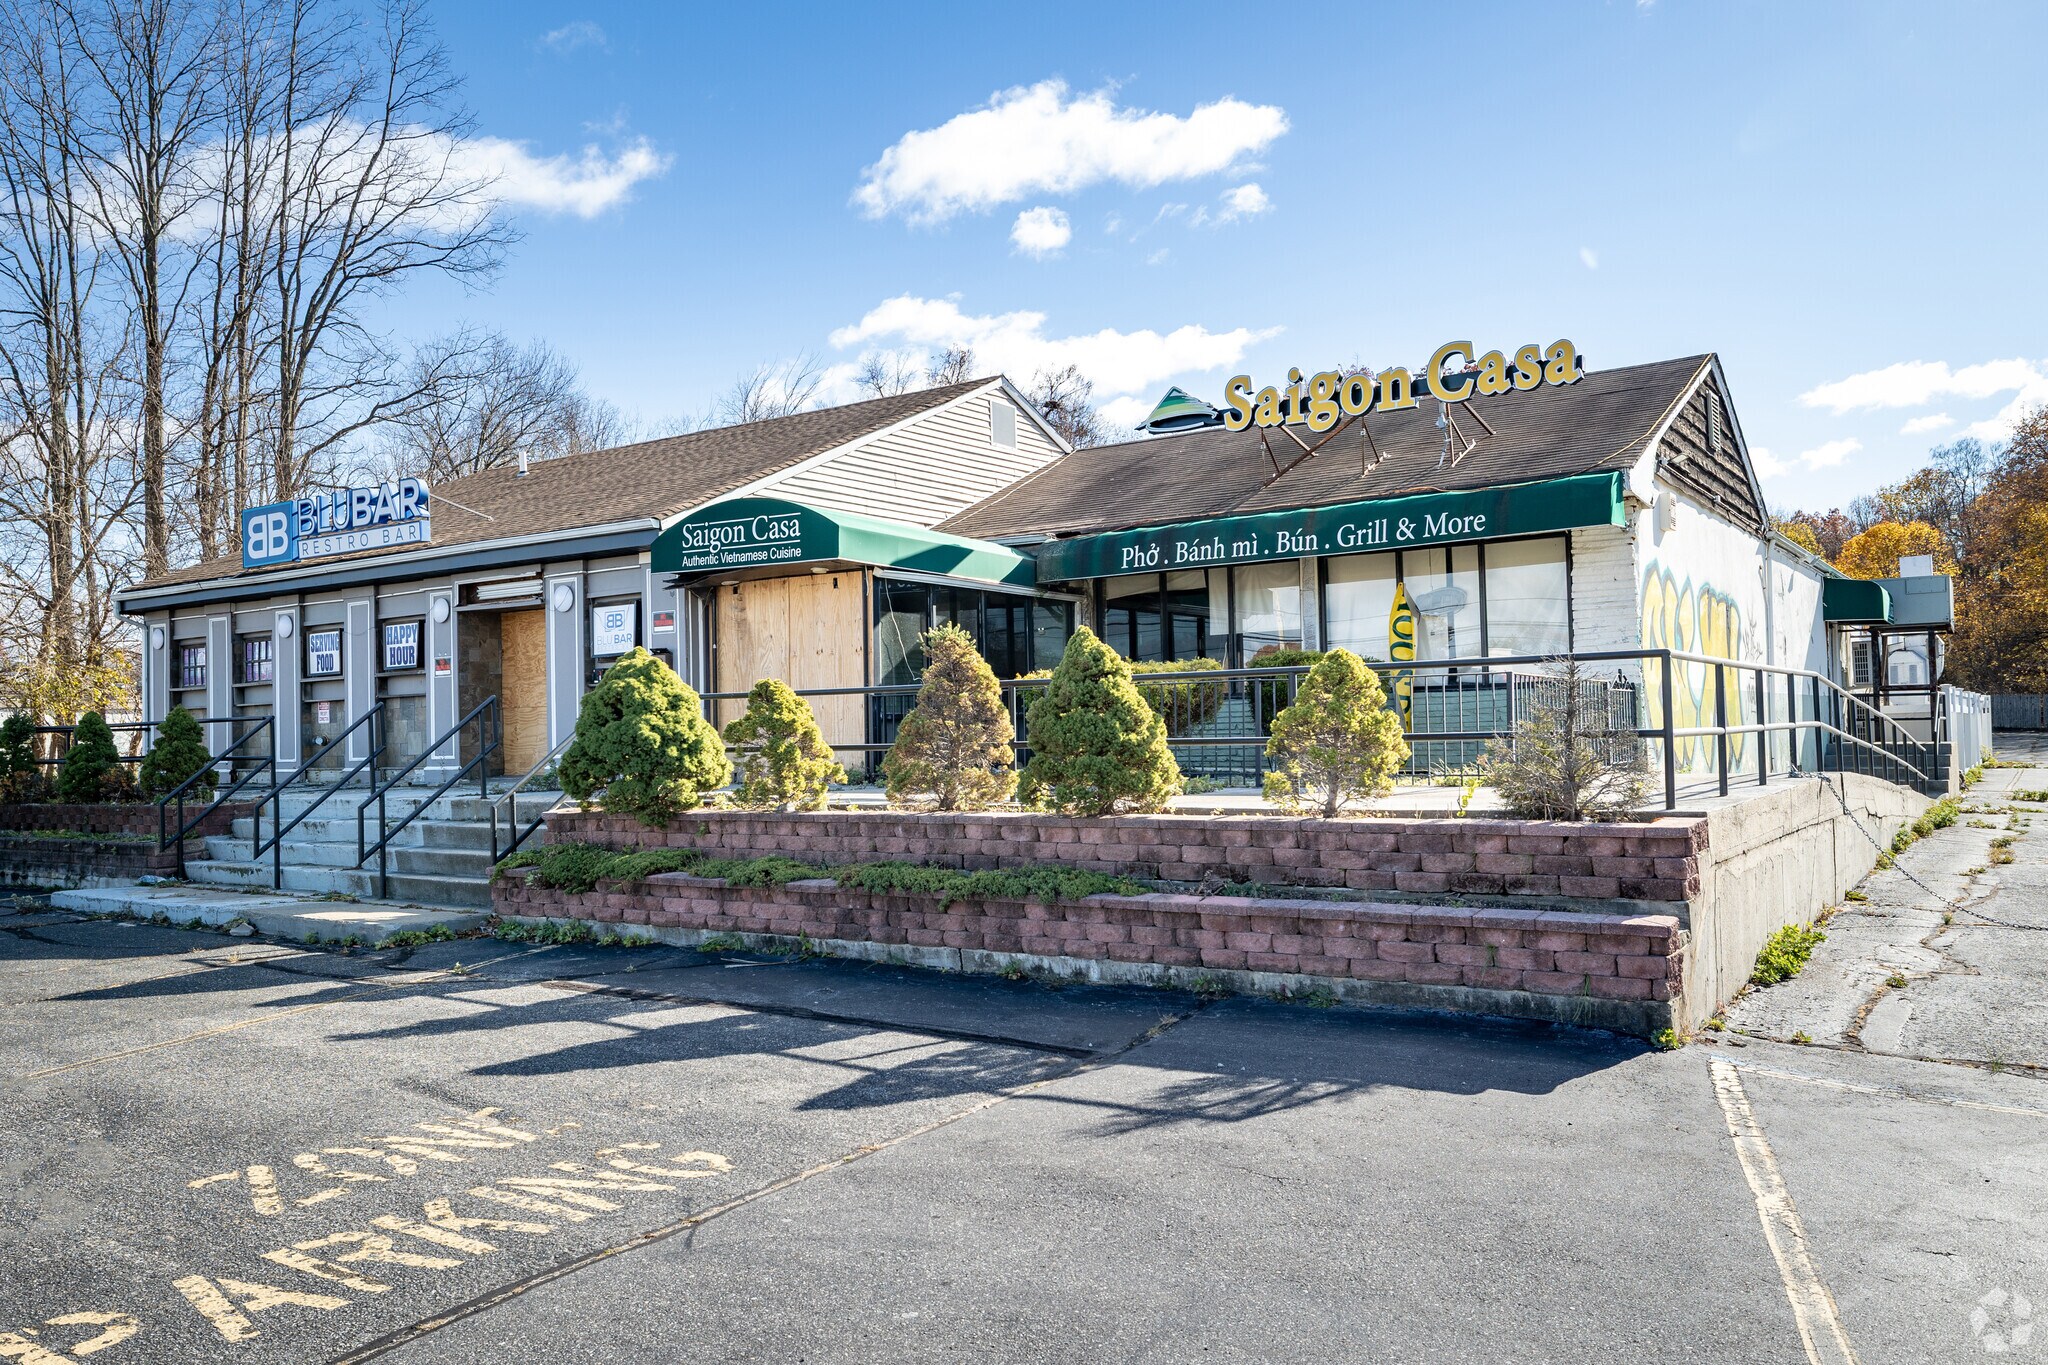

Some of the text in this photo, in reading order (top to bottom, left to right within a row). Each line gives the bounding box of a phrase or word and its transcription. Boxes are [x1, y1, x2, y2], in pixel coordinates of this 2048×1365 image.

[1223, 338, 1585, 433] Saigon Casa
[302, 524, 417, 556] RESTRO BAR
[682, 515, 801, 553] Saigon Casa
[1121, 543, 1160, 569] Phở
[1175, 536, 1226, 563] Bánh
[1231, 533, 1258, 558] mì
[1276, 528, 1318, 554] Bún
[1337, 518, 1388, 548] Grill
[1396, 517, 1417, 541] &
[1422, 512, 1486, 538] More
[682, 547, 801, 567] Authentic Vietnamese Cuisine
[311, 632, 340, 653] SERVING
[386, 624, 418, 645] HAPPY
[316, 653, 334, 672] FOOD
[390, 645, 415, 666] HOUR
